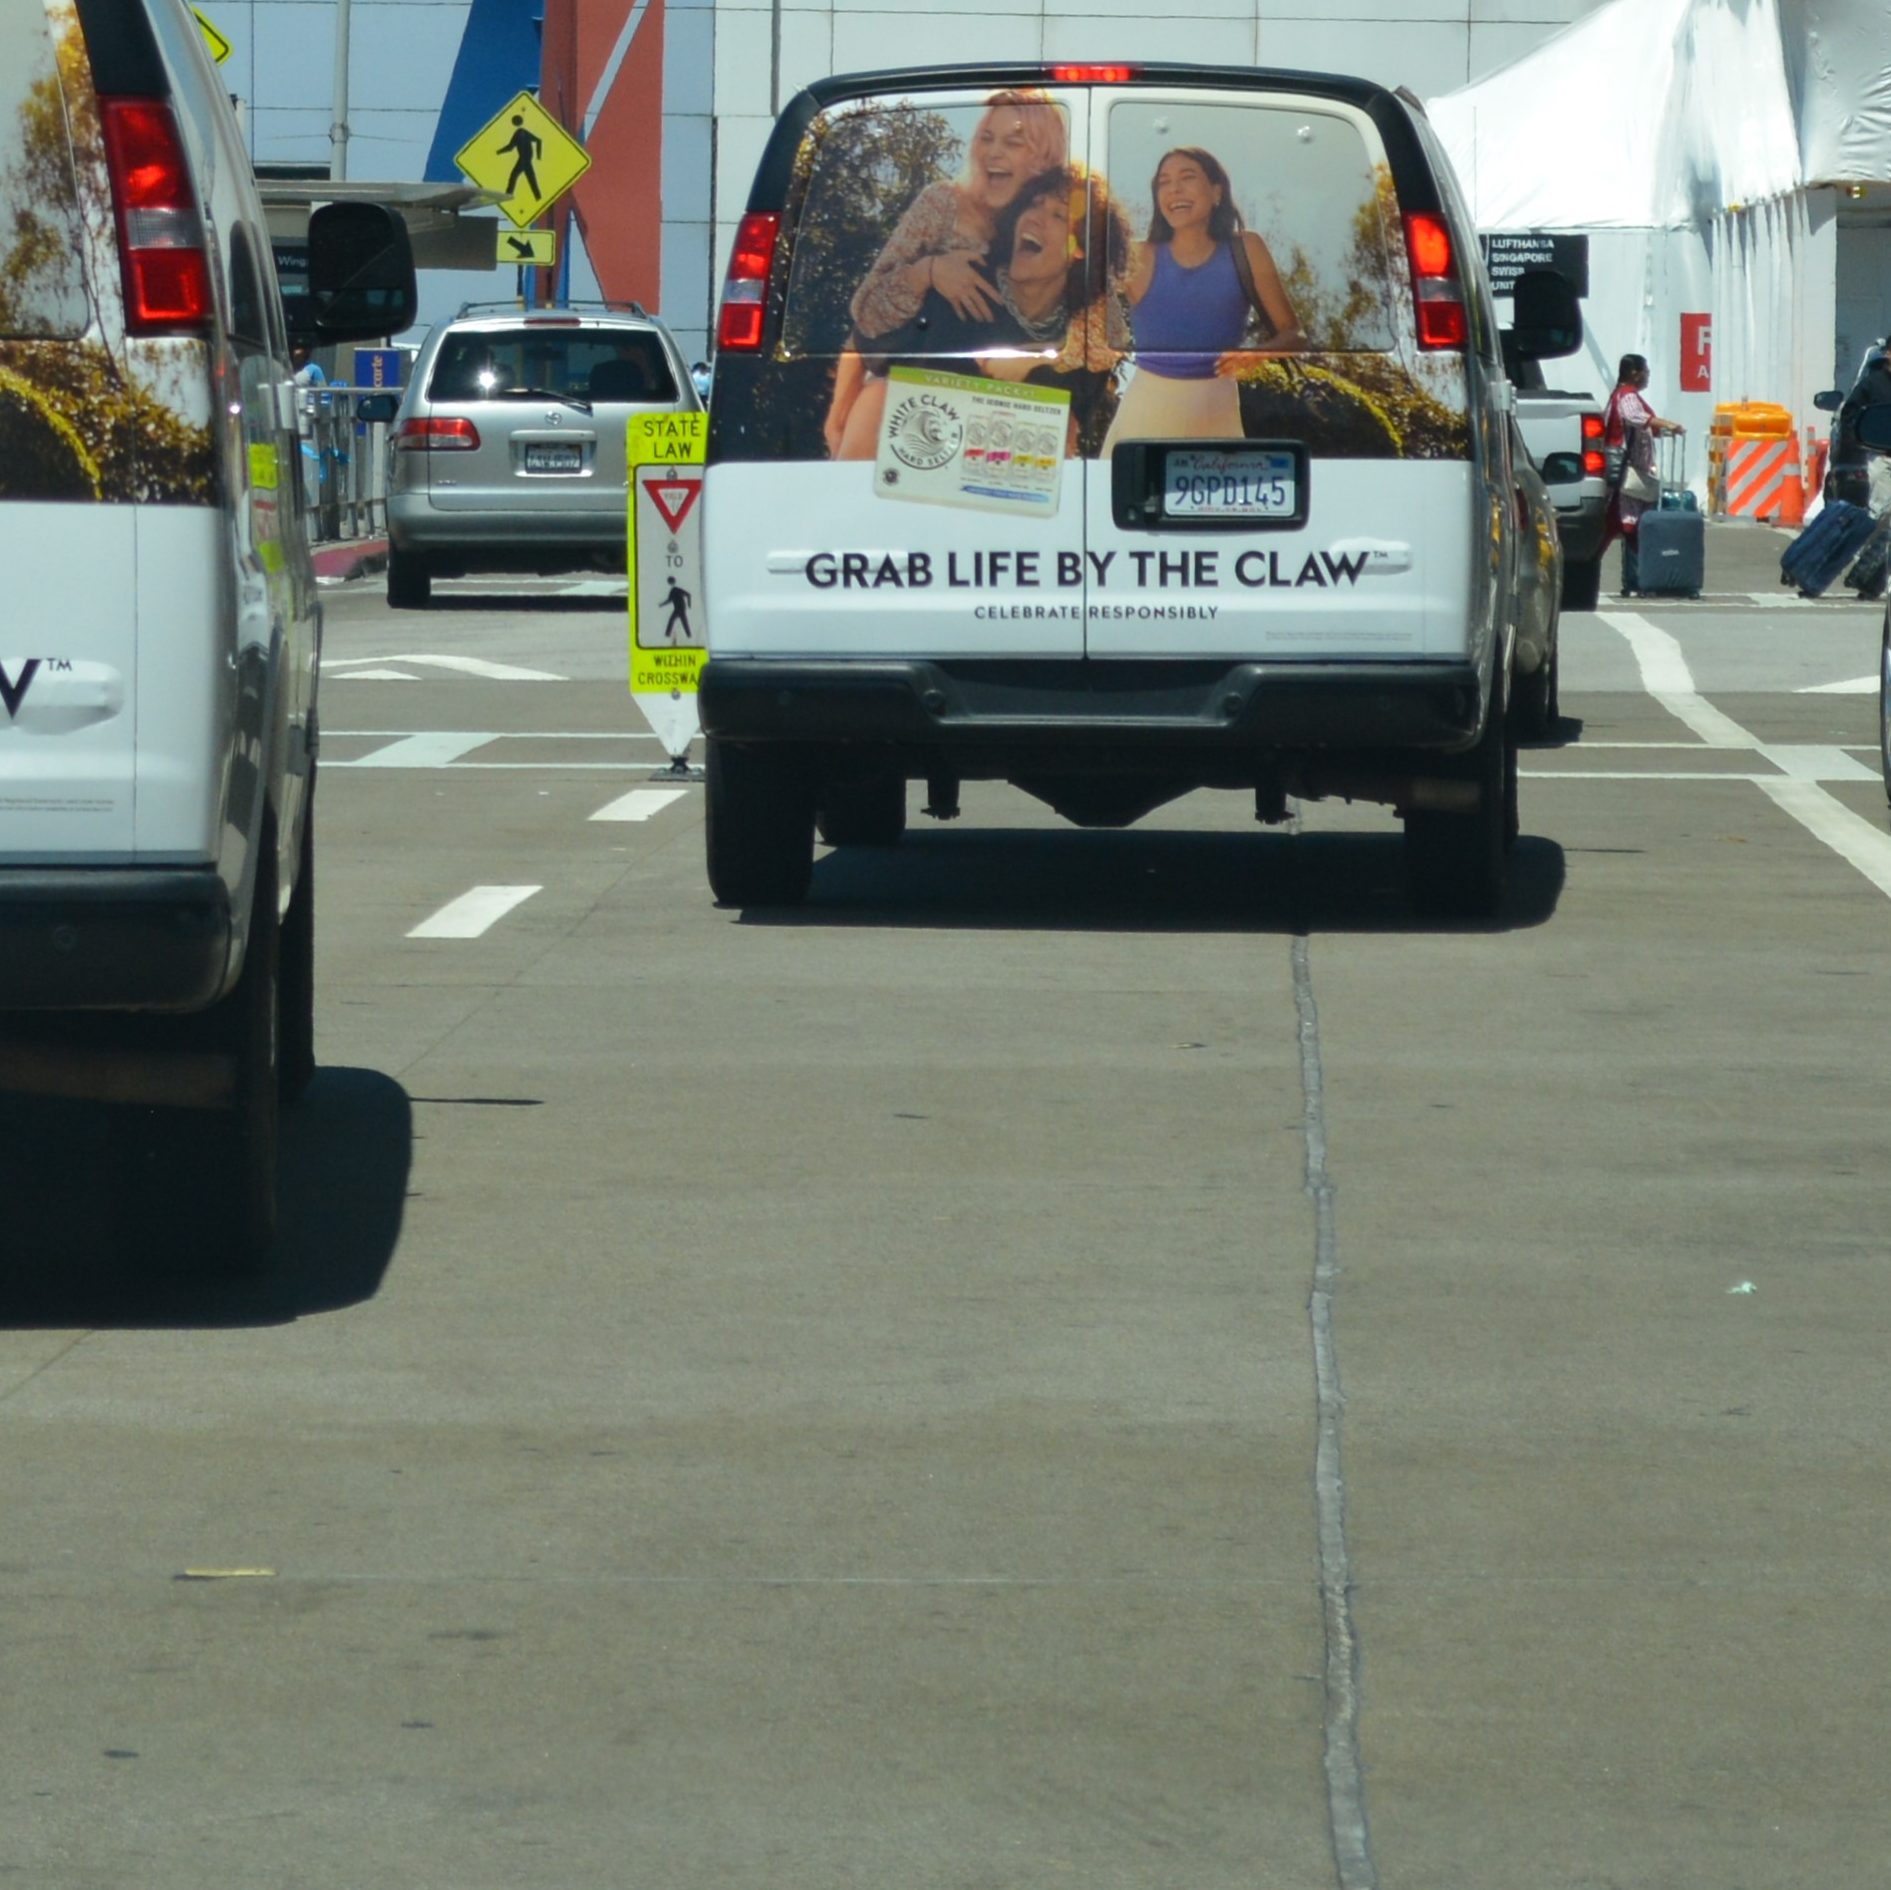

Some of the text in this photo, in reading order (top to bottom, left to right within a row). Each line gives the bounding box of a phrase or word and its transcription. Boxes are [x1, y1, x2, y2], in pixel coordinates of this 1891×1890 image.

[1492, 238, 1555, 249] LUFTHANSA
[1491, 252, 1553, 263] SINGAPORE
[1491, 280, 1515, 290] UNIT
[888, 393, 960, 439] WHITE CLAW
[643, 419, 702, 438] STATE
[653, 442, 693, 459] LAW
[1192, 454, 1269, 475] California
[1174, 475, 1286, 506] 9GPD145
[666, 555, 684, 568] TO
[805, 551, 934, 589] GRAB
[948, 551, 1042, 588] LIFE
[1056, 551, 1117, 588] BY
[1129, 551, 1220, 588] THE
[973, 605, 1220, 621] CELEBRATE RESPONSIBLY
[637, 671, 699, 687] CROSSWA
